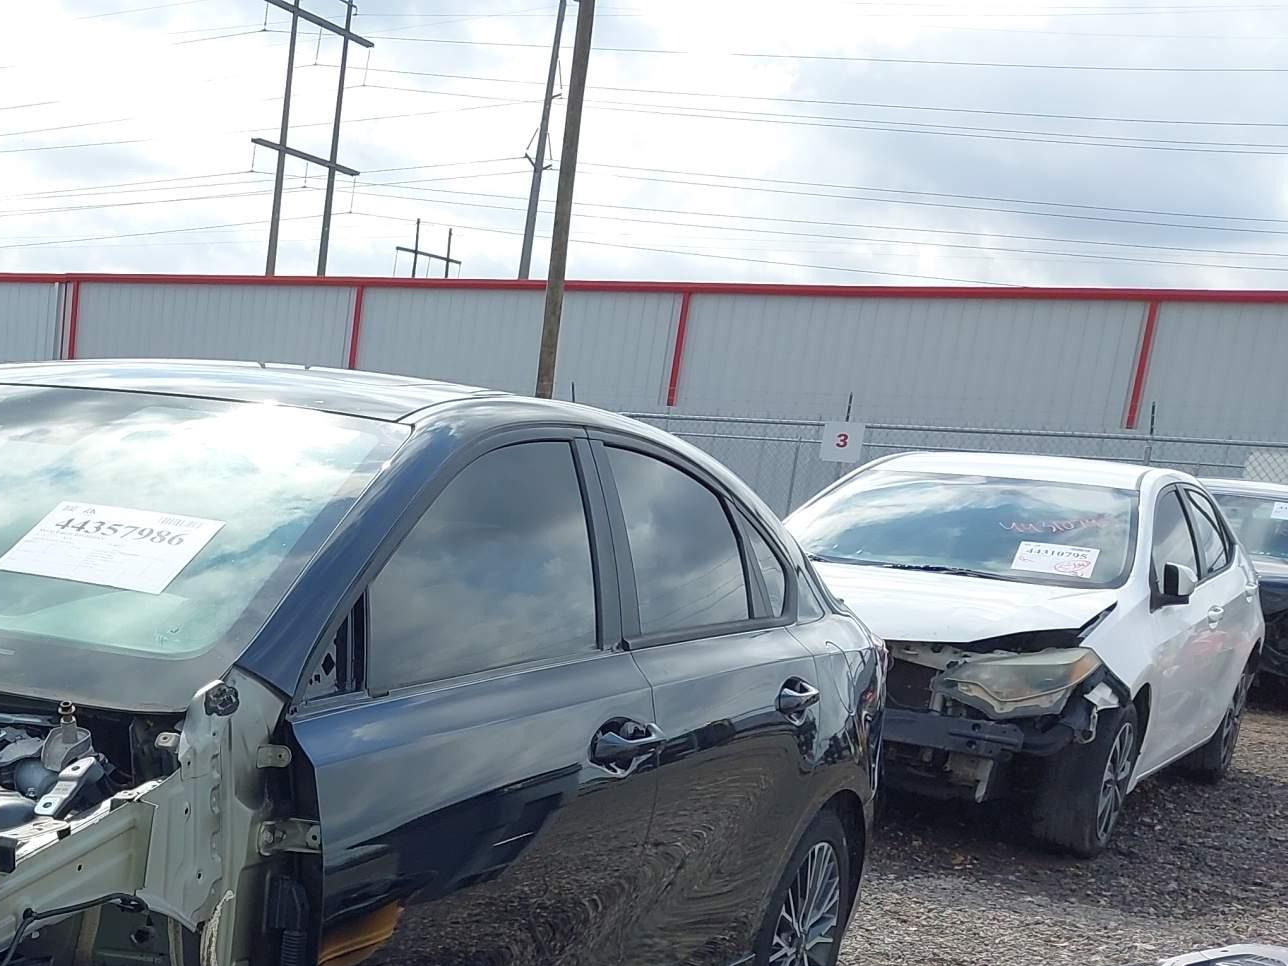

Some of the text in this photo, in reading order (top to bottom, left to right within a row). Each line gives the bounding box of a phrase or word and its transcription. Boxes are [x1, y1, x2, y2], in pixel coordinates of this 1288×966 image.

[835, 433, 849, 448] 3
[55, 517, 185, 547] 44357986
[1025, 547, 1089, 560] 44310795
